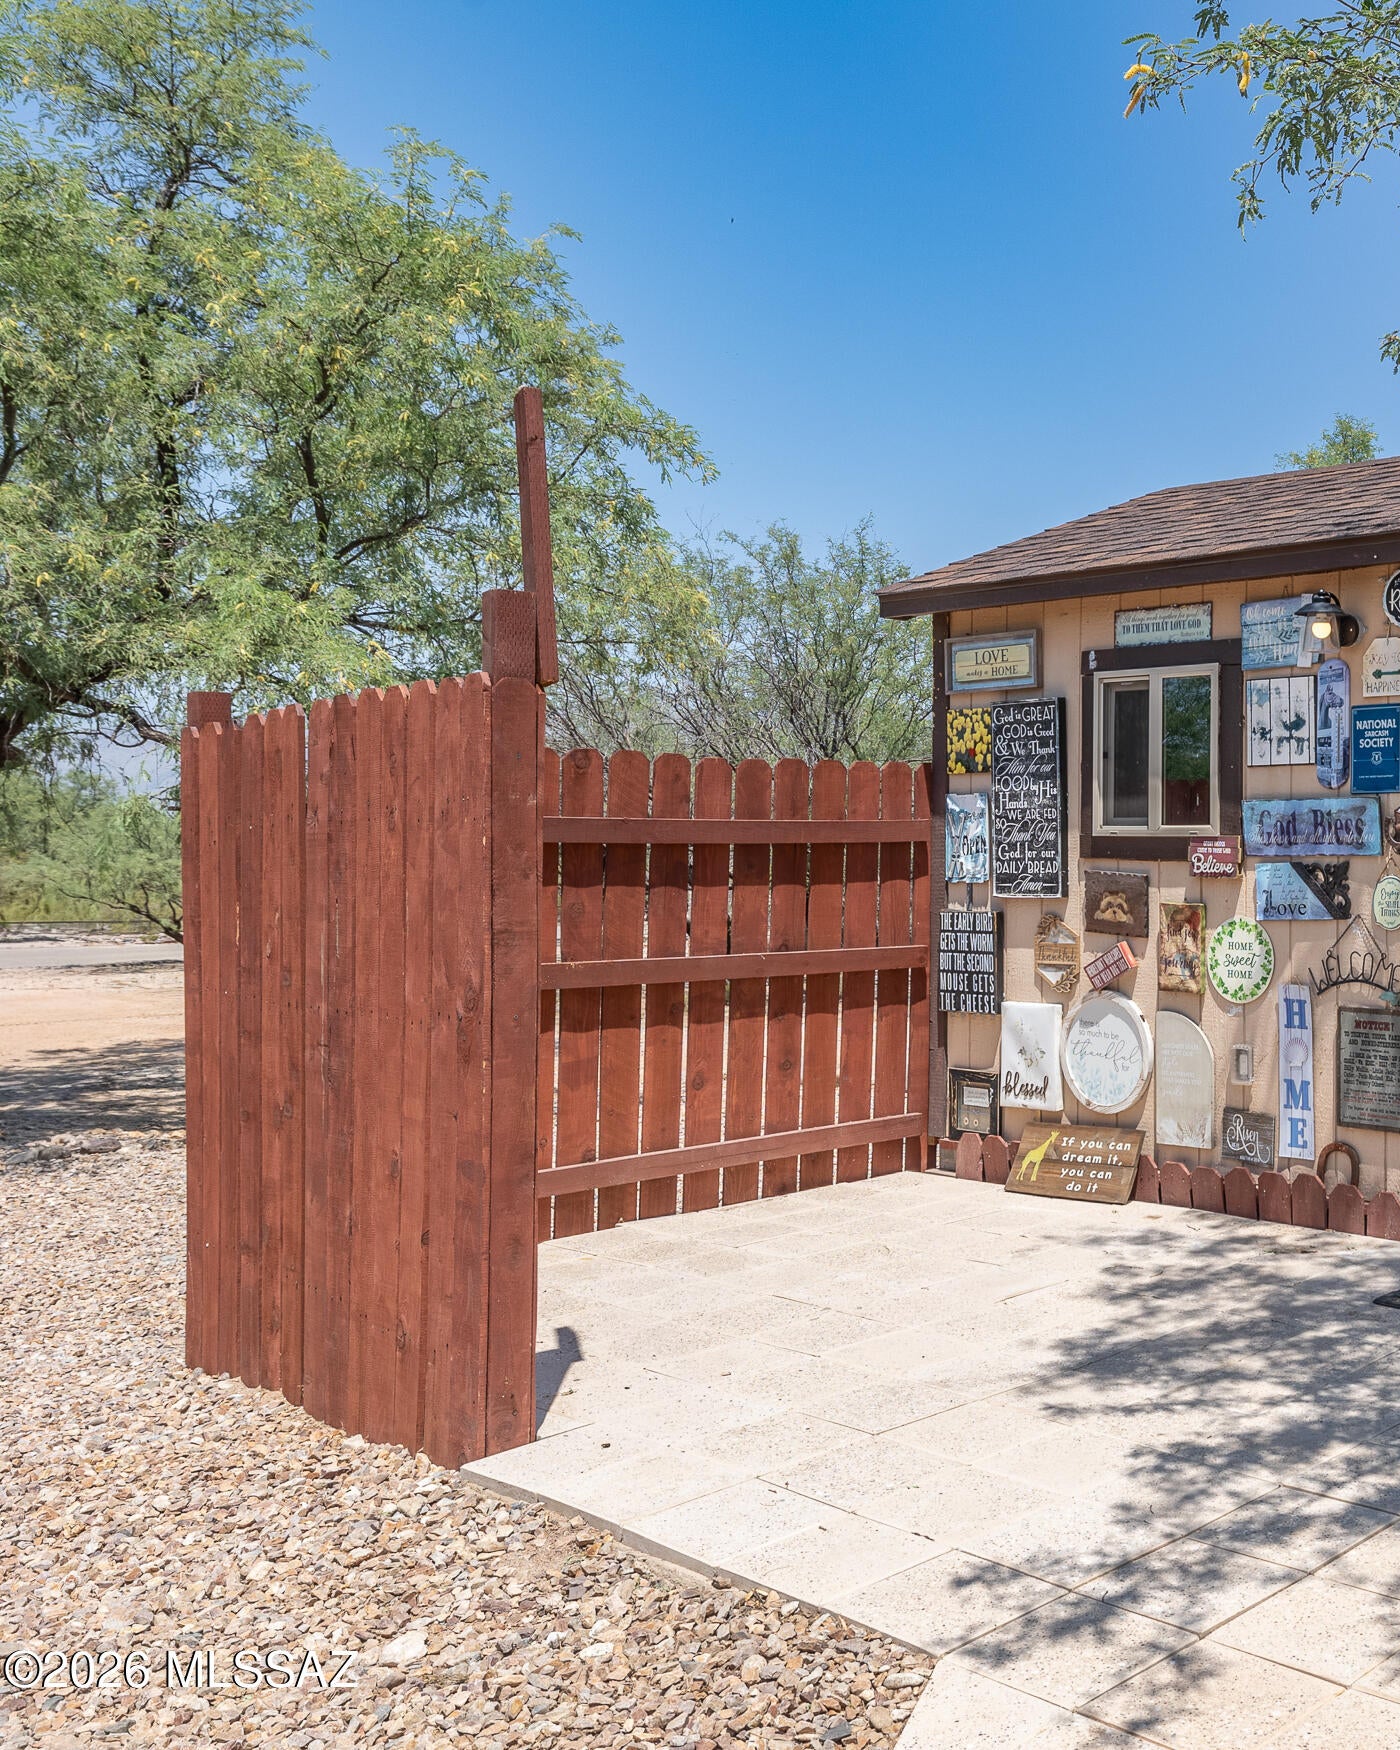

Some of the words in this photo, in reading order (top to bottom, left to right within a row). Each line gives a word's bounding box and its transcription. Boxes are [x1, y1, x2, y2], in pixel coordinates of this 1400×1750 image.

[1122, 624, 1131, 634] TO
[1132, 621, 1150, 634] THEM
[1152, 620, 1168, 632] THAT
[1170, 619, 1187, 631] LOVE
[1188, 618, 1202, 629] GOD
[975, 649, 1009, 665] LOVE
[991, 664, 1018, 677] HOME
[993, 707, 1014, 725] God
[1015, 710, 1021, 719] is
[1022, 705, 1055, 722] GREAT
[1003, 724, 1027, 738] GOD
[1027, 727, 1032, 736] is
[1034, 723, 1054, 737] Good
[1356, 718, 1397, 732] NATIONAL
[995, 735, 1010, 756] &
[1010, 742, 1025, 756] We
[1028, 740, 1056, 755] Thank
[1360, 738, 1395, 750] SOCIETY
[995, 776, 1029, 792] FOOD
[1030, 779, 1039, 793] by
[1035, 780, 1057, 804] His
[1007, 810, 1021, 820] WE
[1026, 809, 1040, 820] ARE
[1043, 808, 1057, 819] FED
[1260, 809, 1297, 847] God
[1311, 807, 1368, 847] Bless
[1025, 842, 1037, 863] for
[1041, 849, 1055, 858] our
[996, 860, 1026, 874] DAILY
[1028, 861, 1058, 874] BREAD
[1192, 853, 1234, 873] Believe
[1262, 890, 1307, 918] Love
[940, 913, 953, 931] THE
[954, 913, 974, 931] EARLY
[975, 912, 993, 932] BIRD
[940, 933, 956, 951] GETS
[957, 933, 969, 951] THE
[970, 934, 994, 952] WORM
[1228, 942, 1254, 951] HOME
[940, 952, 953, 970] BUT
[953, 953, 966, 971] THE
[966, 954, 994, 972] SECOND
[1223, 952, 1260, 968] Sweet
[940, 972, 968, 992] MOUSE
[973, 974, 995, 993] GETS
[1227, 970, 1253, 980] HOME
[940, 992, 956, 1011] THE
[960, 993, 996, 1014] CHEESE
[1354, 1020, 1395, 1032] NOTICE!
[1087, 1029, 1102, 1038] much
[1104, 1030, 1110, 1038] to
[1111, 1031, 1120, 1040] be
[1070, 1039, 1141, 1072] thankful
[1002, 1071, 1049, 1101] blessed
[1061, 1137, 1076, 1147] If
[1080, 1140, 1103, 1150] you
[1109, 1142, 1131, 1151] can
[1062, 1152, 1102, 1164] dream
[1108, 1154, 1122, 1166] it,
[1060, 1168, 1084, 1178] you
[1090, 1170, 1113, 1180] can
[1066, 1181, 1081, 1192] do
[1086, 1183, 1098, 1192] it
